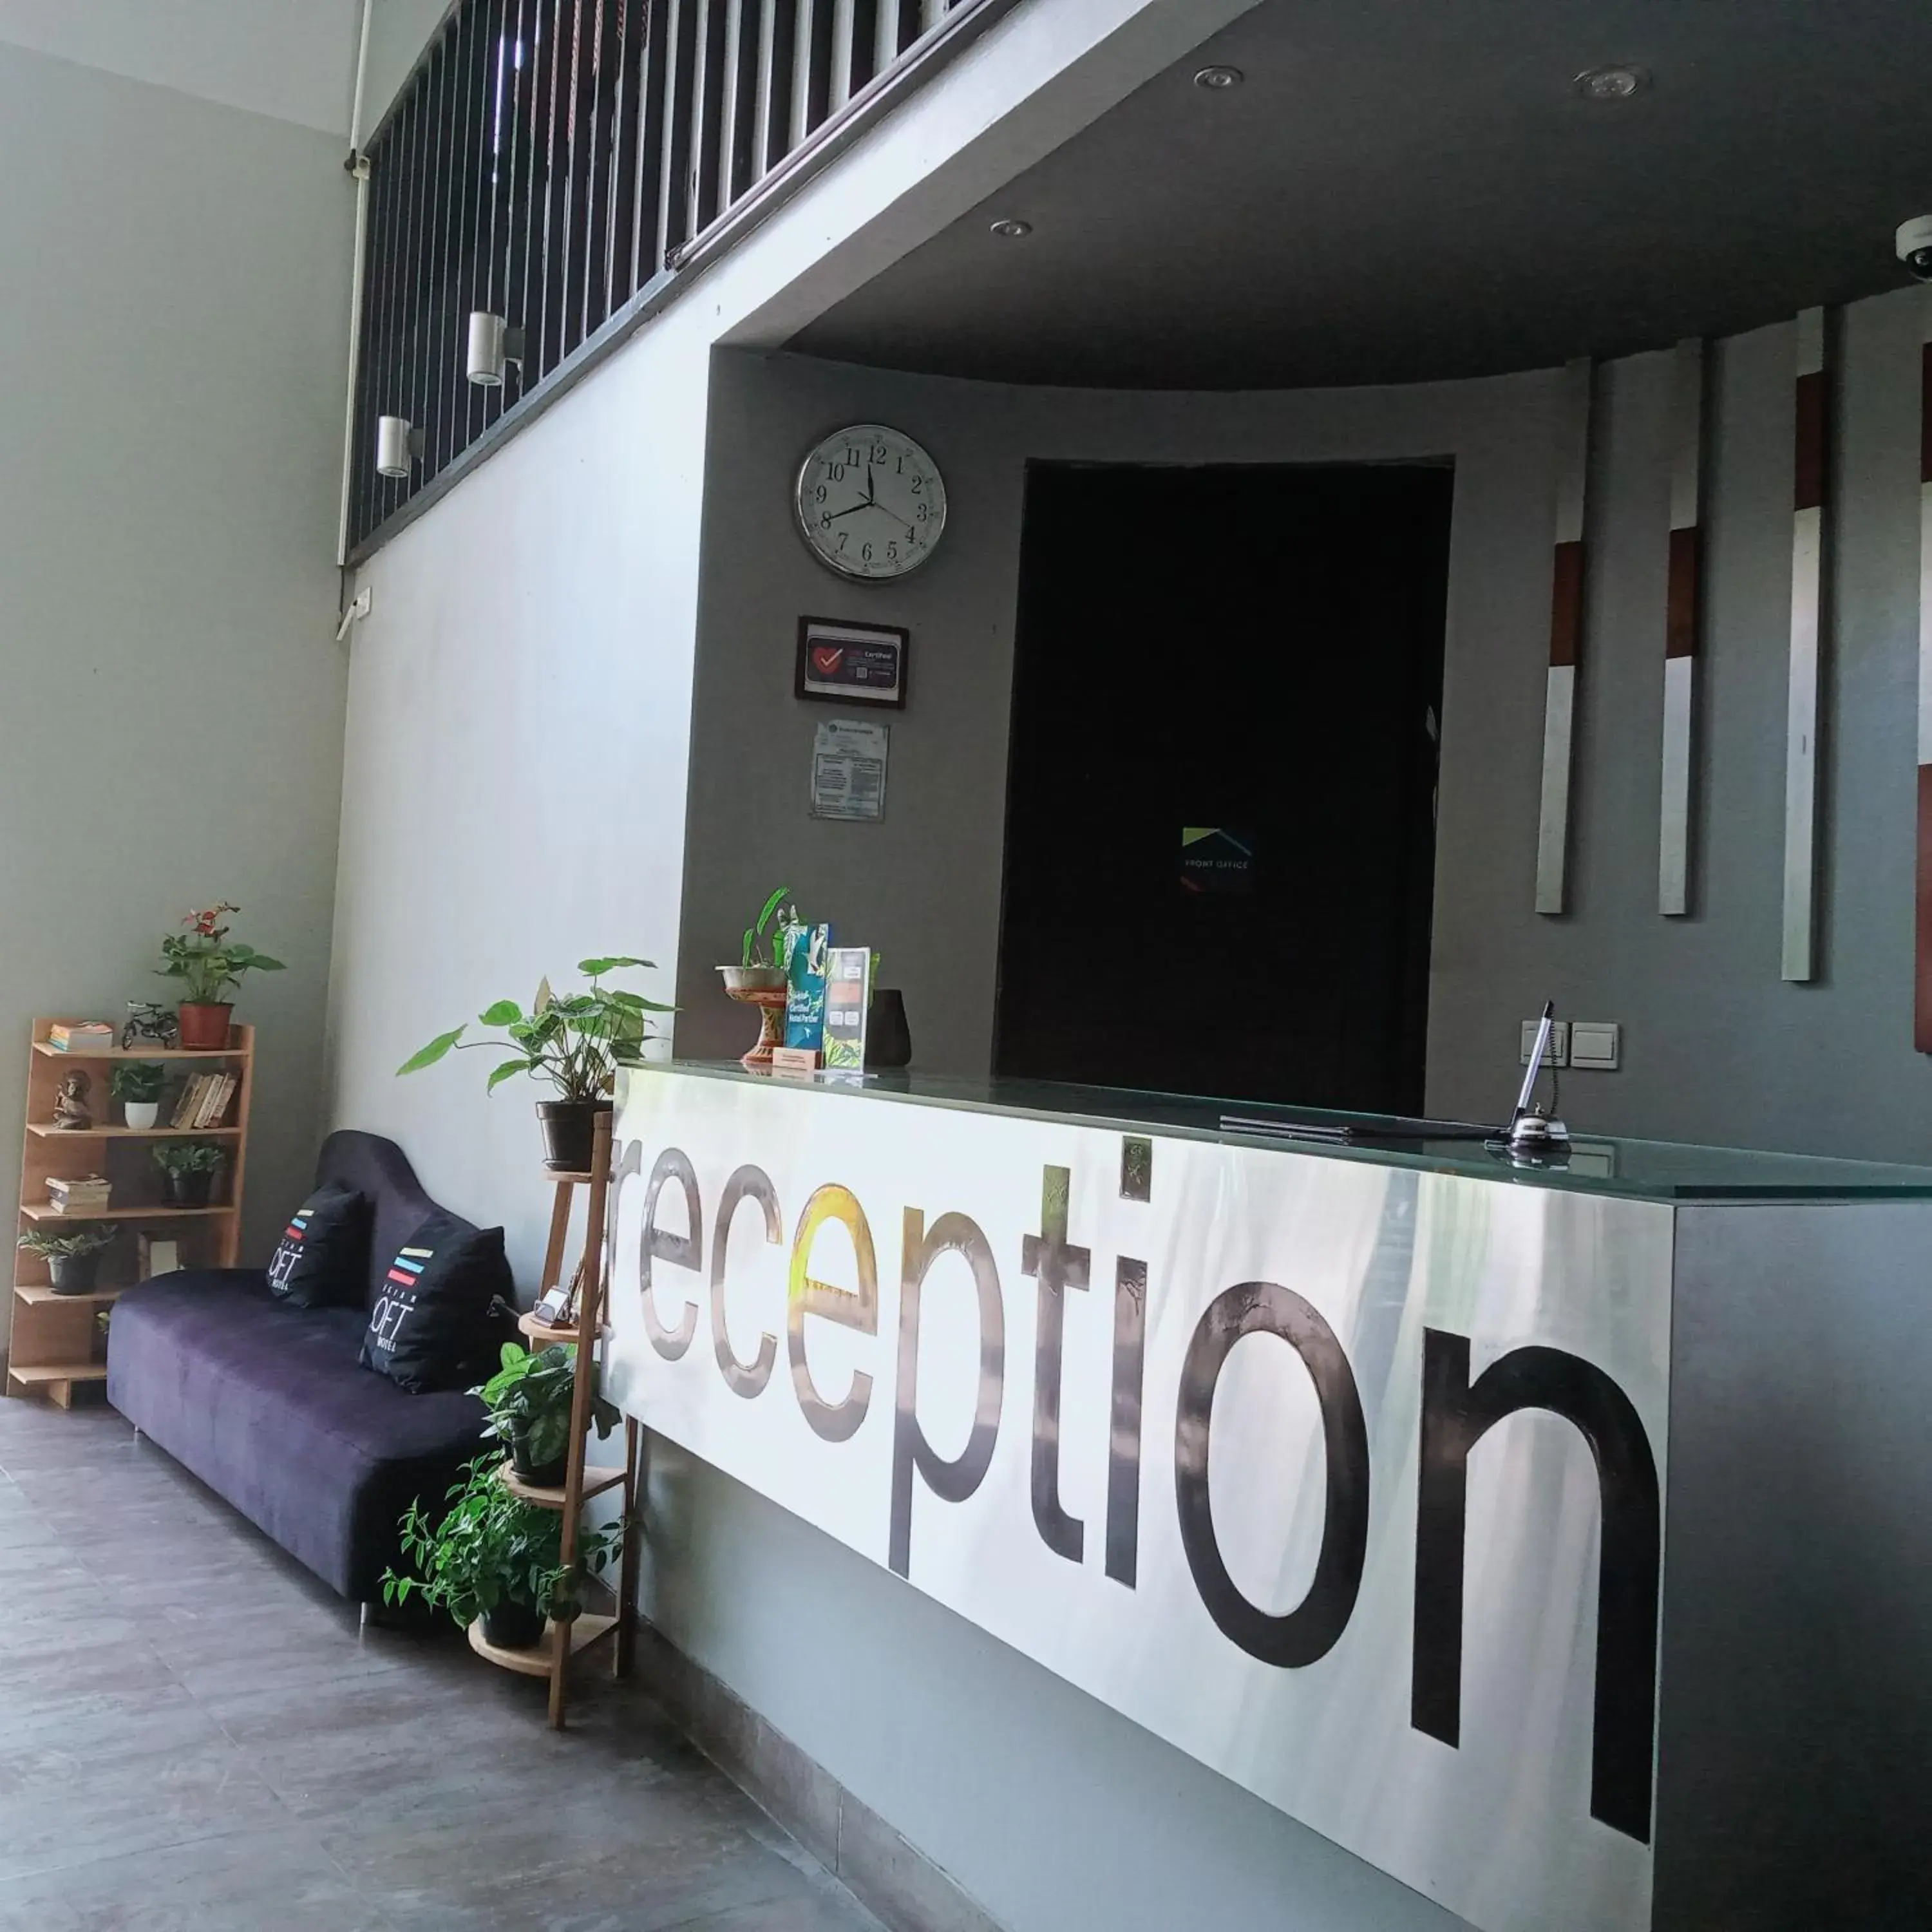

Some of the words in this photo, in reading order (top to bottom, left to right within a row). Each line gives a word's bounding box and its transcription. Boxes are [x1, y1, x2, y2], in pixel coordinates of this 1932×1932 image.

[844, 448, 859, 468] 11
[869, 445, 886, 464] 12
[826, 462, 844, 482] 10
[896, 456, 902, 474] 1
[911, 475, 922, 494] 2
[816, 485, 827, 504] 9
[820, 511, 831, 529] 8
[917, 504, 927, 522] 3
[838, 533, 848, 551] 7
[905, 526, 915, 544] 4
[862, 543, 872, 562] 6
[887, 541, 896, 559] 5
[1185, 860, 1213, 868] FRONT
[1217, 860, 1248, 869] OFFICE
[269, 1247, 302, 1282] OFT
[371, 1296, 414, 1340] OFT
[609, 1135, 1660, 1845] reception
